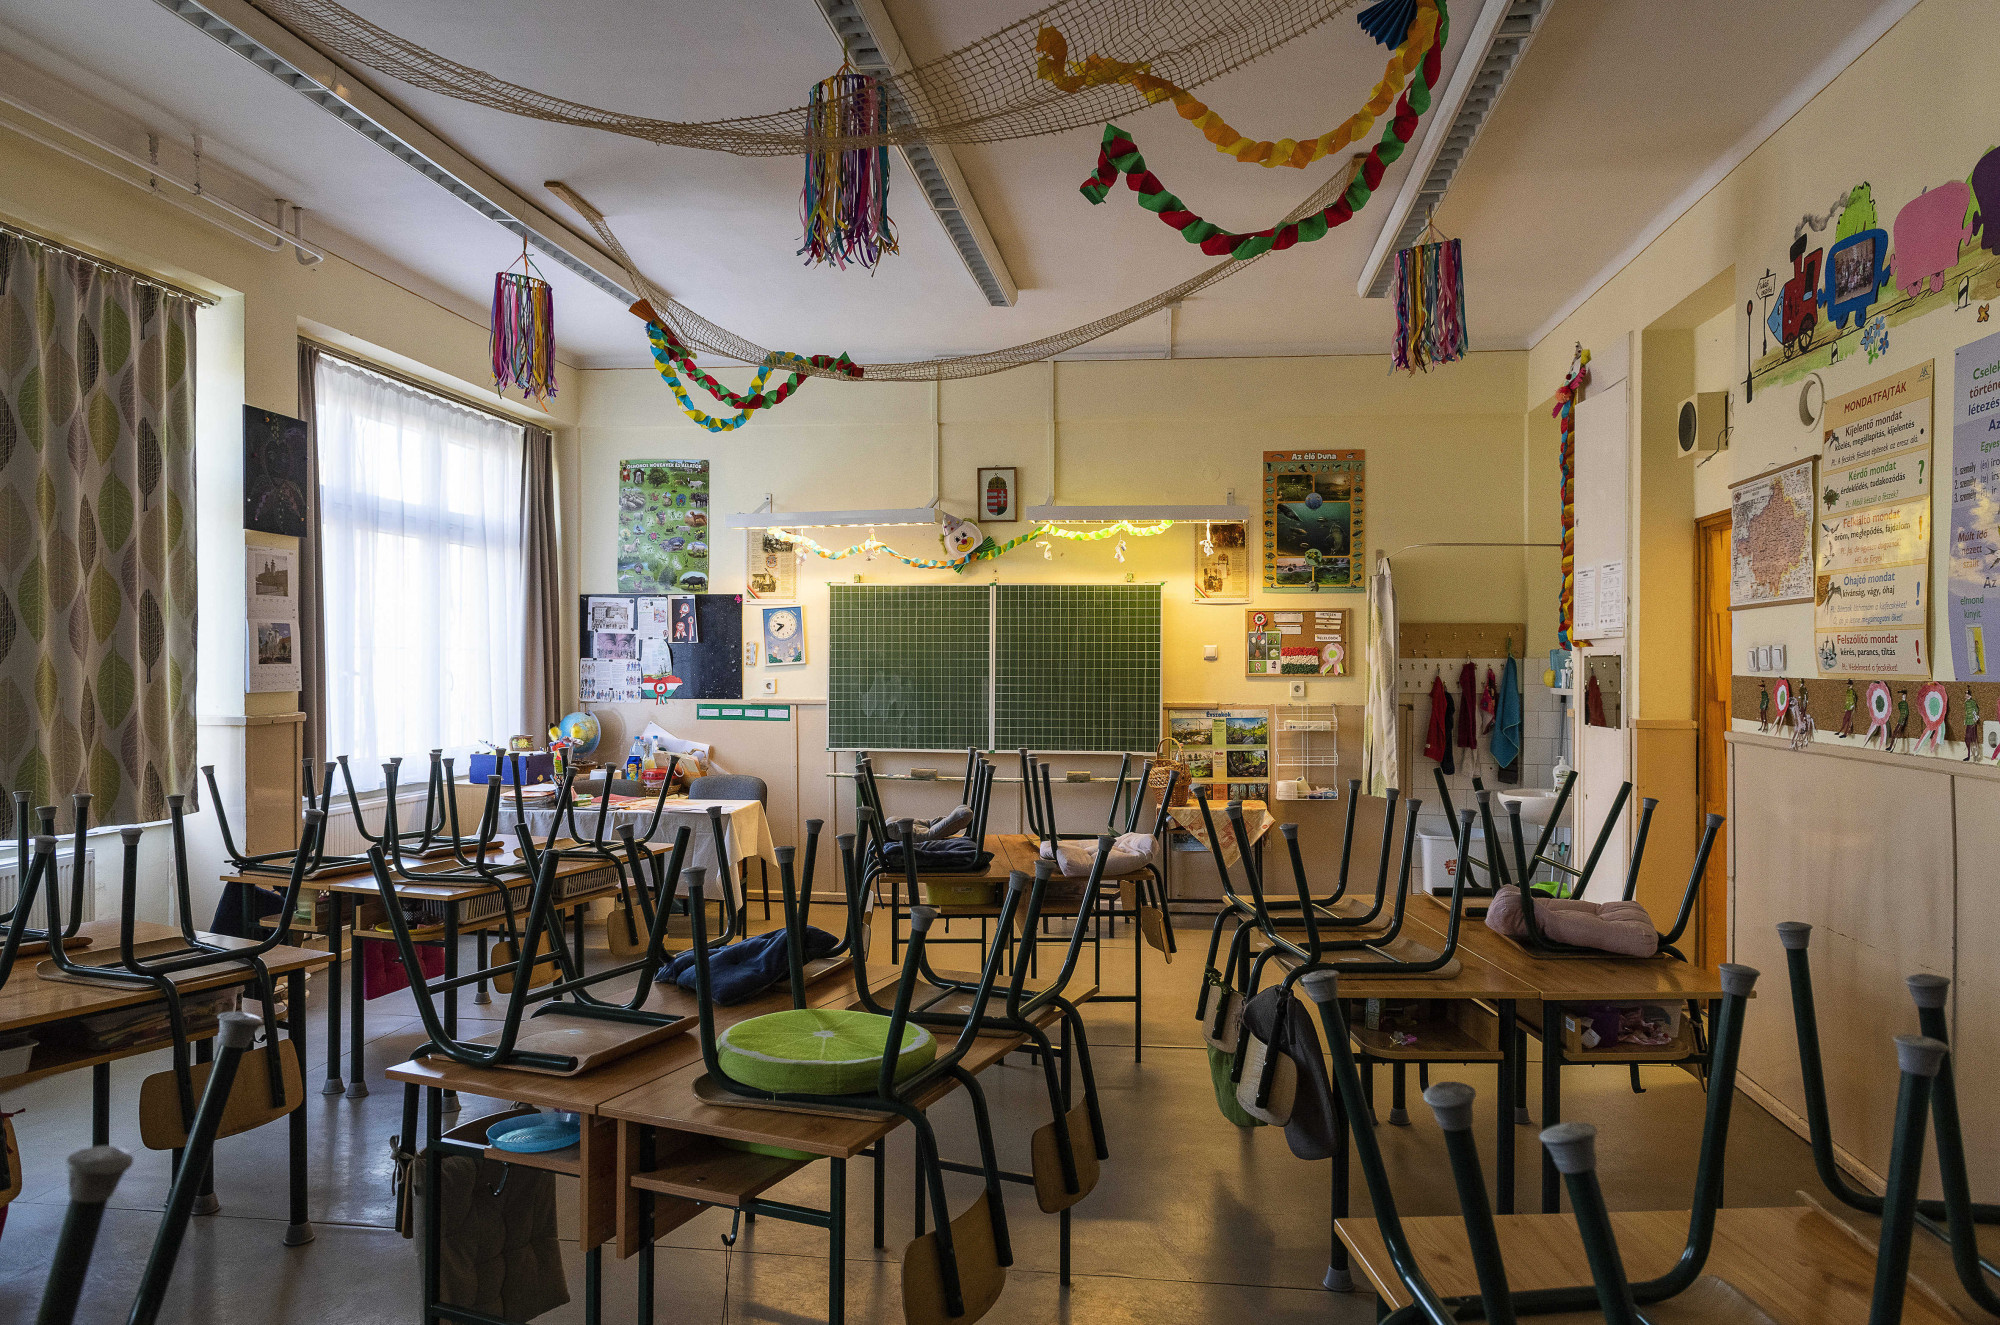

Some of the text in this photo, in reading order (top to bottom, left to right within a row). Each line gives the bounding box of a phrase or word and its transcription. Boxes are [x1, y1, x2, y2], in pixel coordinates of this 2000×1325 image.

[1844, 381, 1907, 414] MONDATFAJTÁK
[1968, 397, 2000, 416] létezés
[1845, 410, 1903, 437] Kijelentő mondat
[1834, 441, 1852, 452] közlés,
[1852, 430, 1886, 446] megállapítás,
[1887, 420, 1915, 435] kijelentés
[1981, 440, 2000, 453] Egyes
[1291, 452, 1337, 461] Az élő Duna
[1848, 467, 1868, 482] Kérdő
[1869, 461, 1897, 476] mondat
[1840, 473, 1906, 495] érdeklődés, tudakozódás
[1843, 514, 1871, 529] Felkiáltó
[1872, 509, 1901, 523] mondat
[1834, 522, 1911, 541] öröm, meglepődés, fájdalom
[1957, 532, 1975, 542] Múlt
[1961, 545, 1982, 555] nézett
[1843, 574, 1867, 587] Óhajtó
[1867, 572, 1896, 583] mondat
[1983, 576, 1997, 589] Az
[1842, 585, 1895, 598] kívánság, vágy, óhaj
[1960, 594, 1985, 606] elmond
[1963, 609, 1982, 620] kinyit
[1836, 634, 1869, 645] Felszólító
[1870, 633, 1898, 644] mondat
[1840, 647, 1896, 659] kérés, parancs, tiltás
